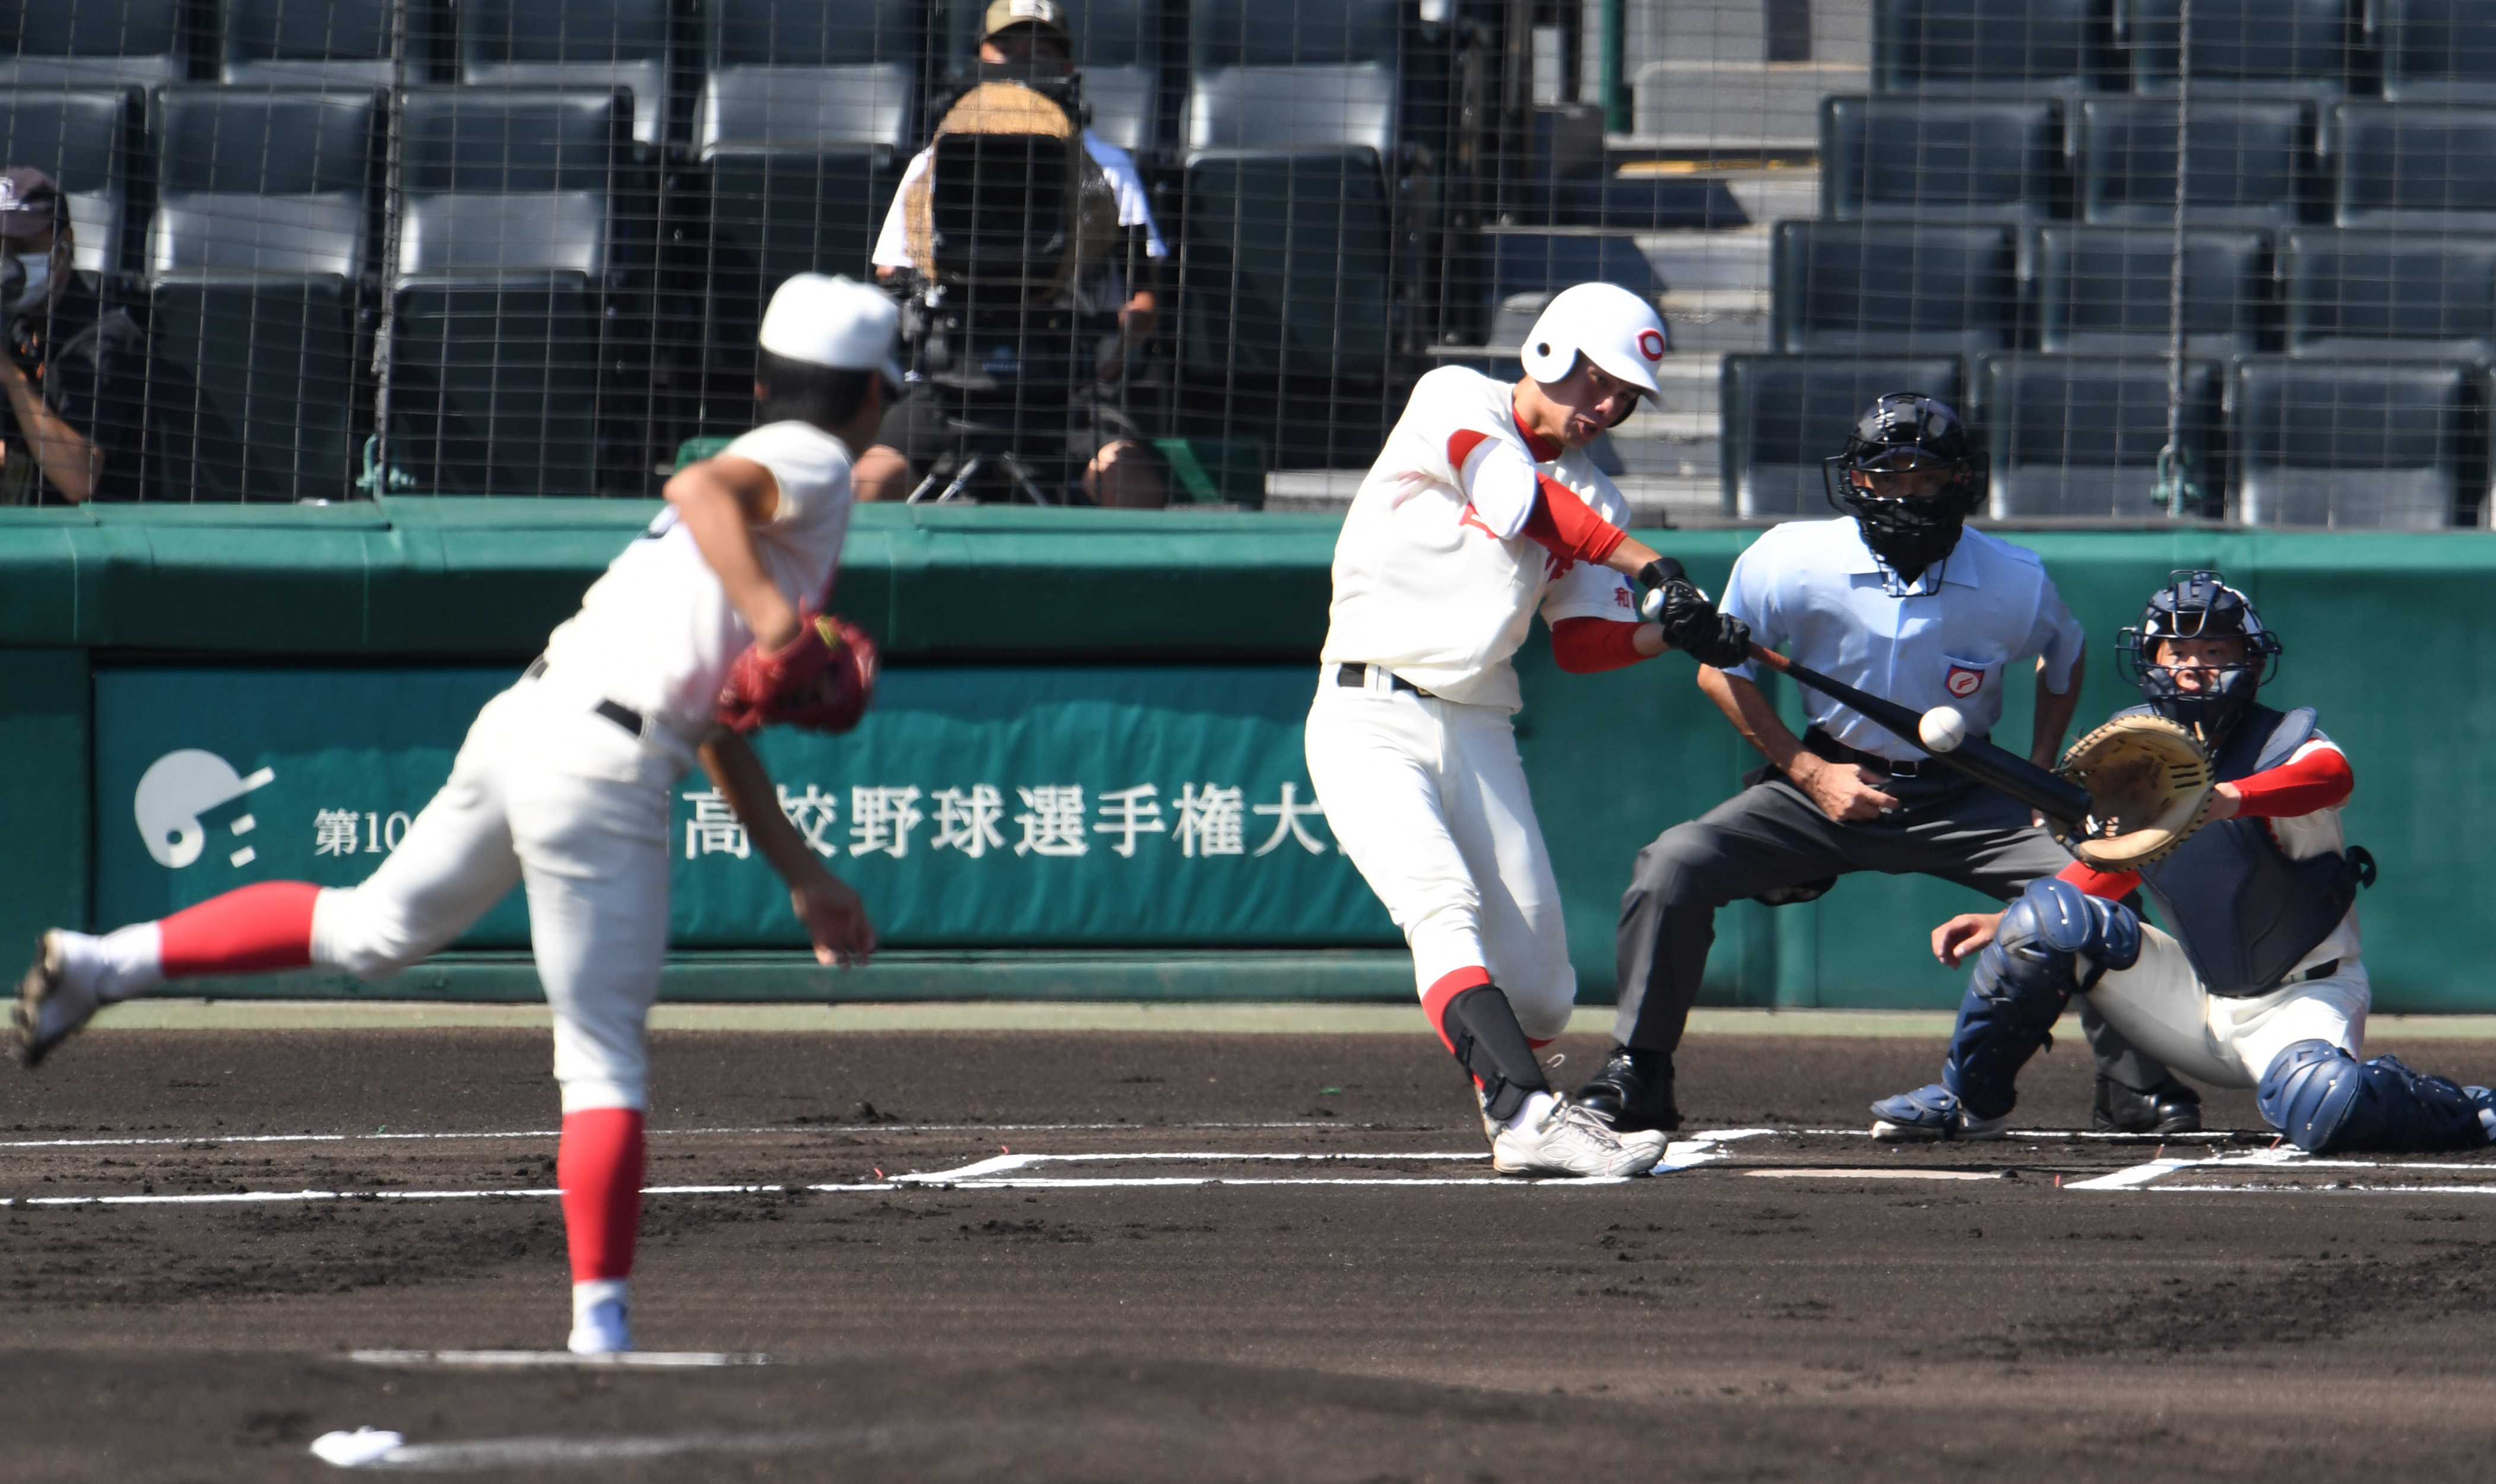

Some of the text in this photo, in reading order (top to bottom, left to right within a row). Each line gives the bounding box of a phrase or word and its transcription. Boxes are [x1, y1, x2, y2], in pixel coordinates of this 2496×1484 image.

[1614, 586, 1636, 608] 和
[682, 783, 1347, 858] 高校野球選手権大
